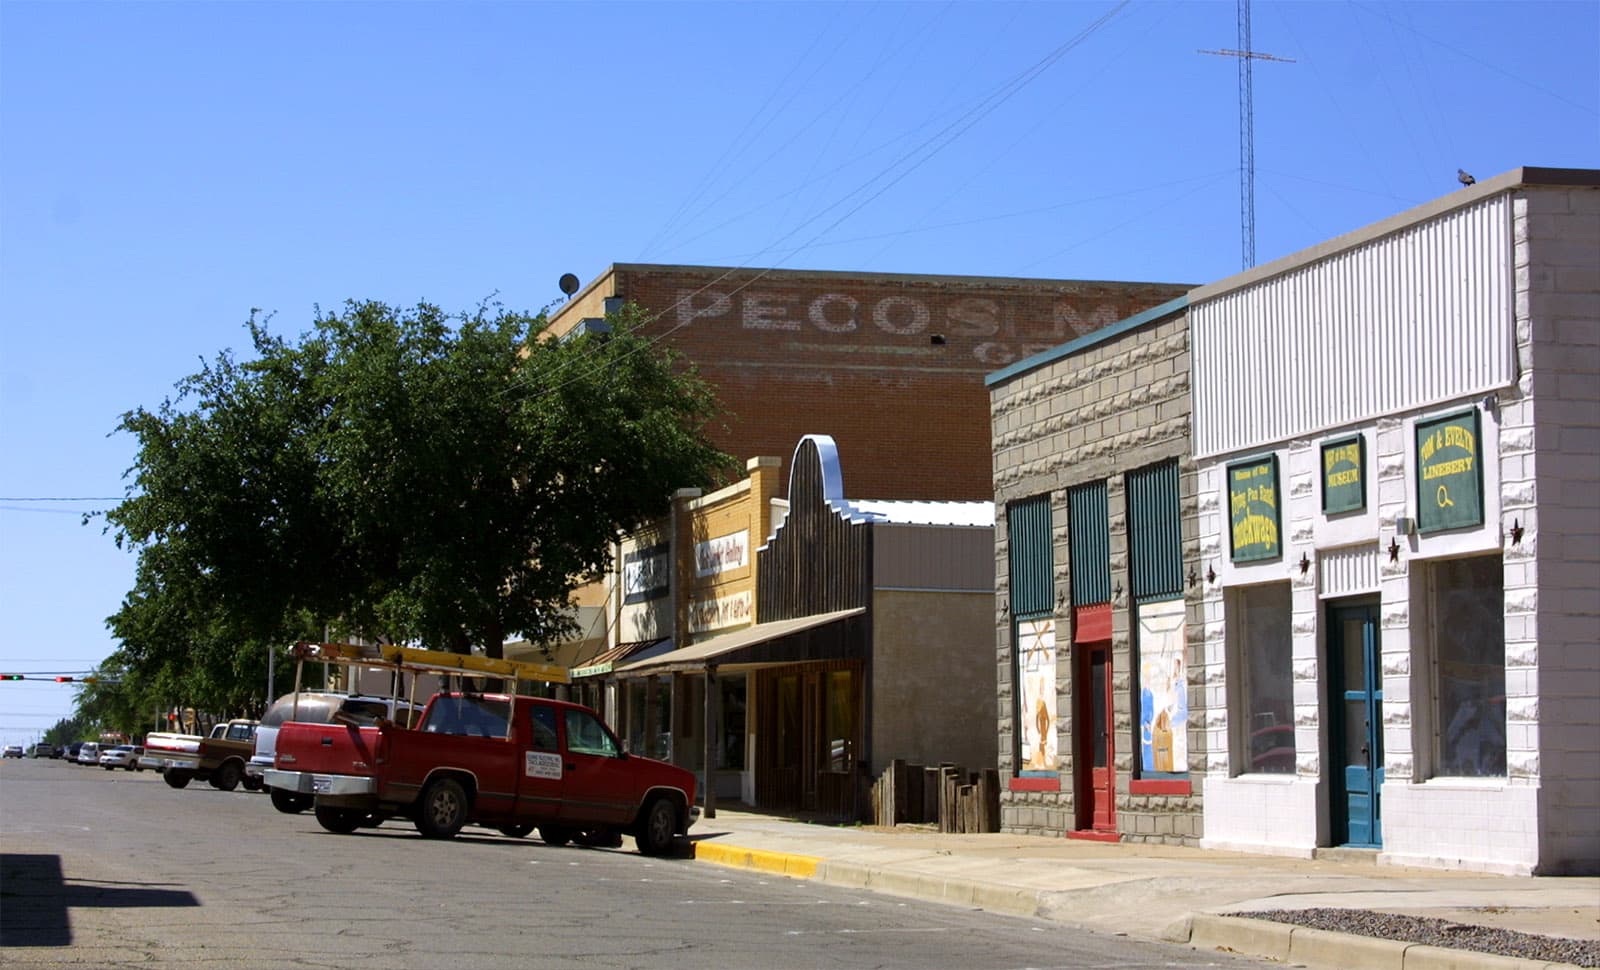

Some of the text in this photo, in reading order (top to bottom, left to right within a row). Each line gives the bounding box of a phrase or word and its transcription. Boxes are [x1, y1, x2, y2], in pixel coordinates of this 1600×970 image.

[676, 288, 1000, 337] PECOS
[1436, 430, 1443, 450] &
[1445, 426, 1474, 456] EVELYN
[1328, 469, 1360, 488] MUSEUM
[1423, 457, 1473, 480] LINEBERY
